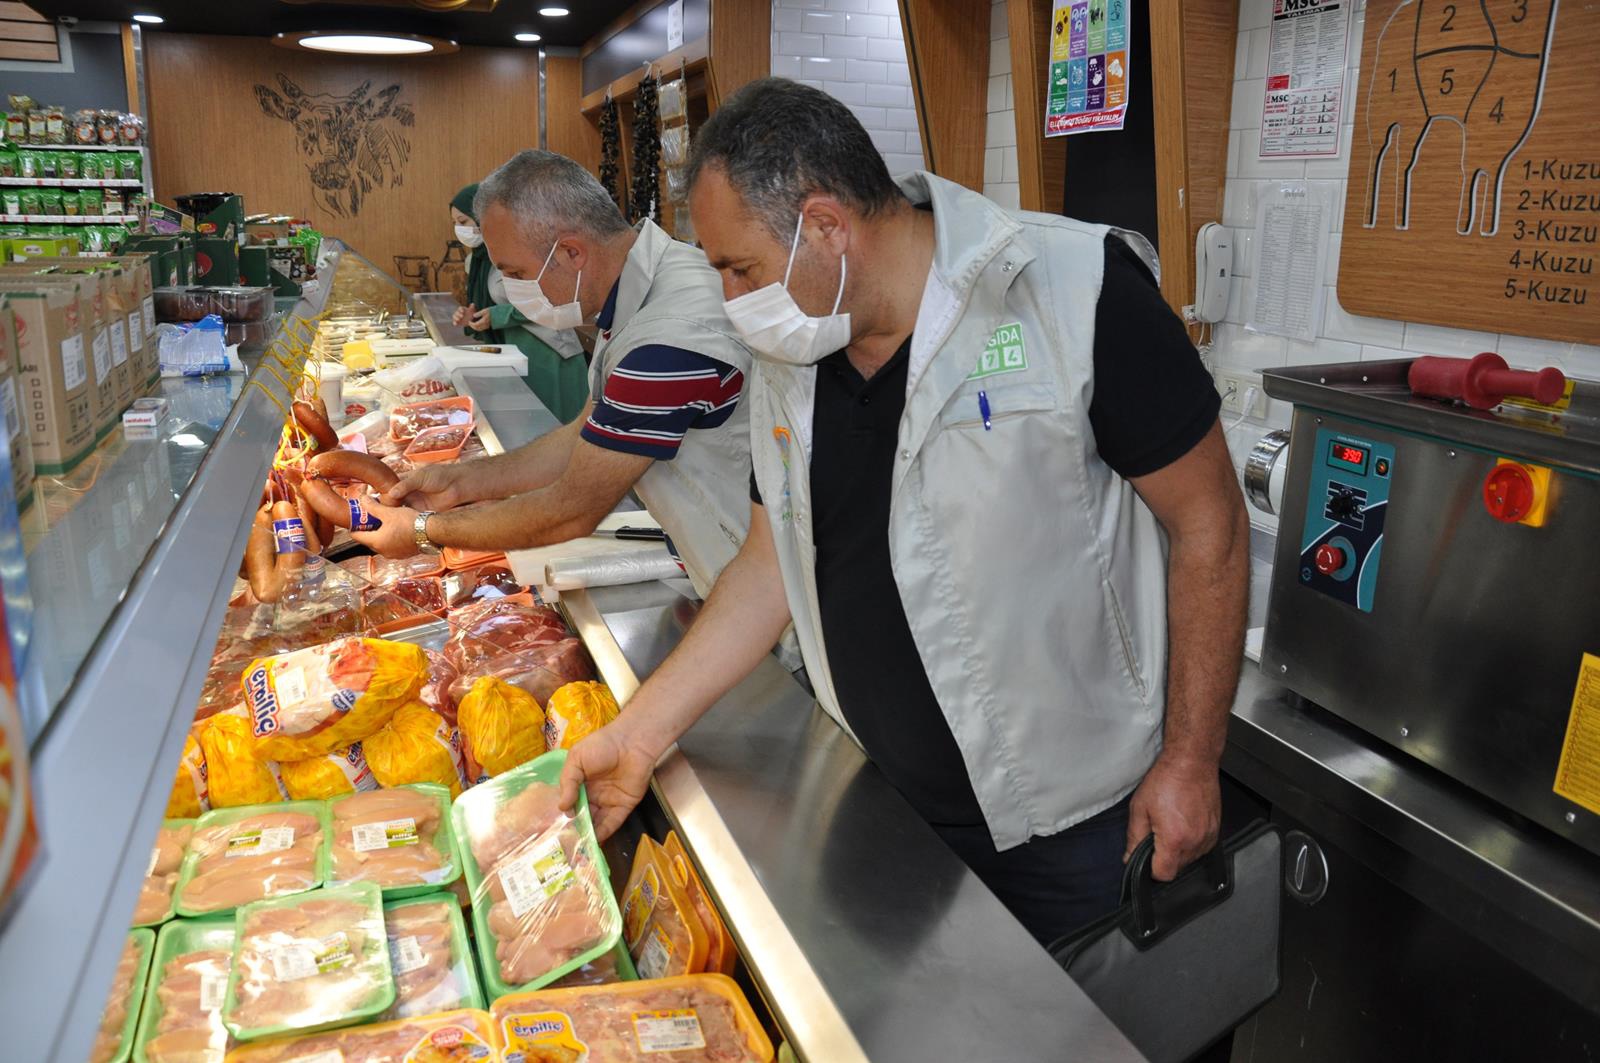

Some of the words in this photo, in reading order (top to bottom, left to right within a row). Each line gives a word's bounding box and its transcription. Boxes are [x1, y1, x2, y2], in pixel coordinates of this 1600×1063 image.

[1440, 4, 1456, 32] 2
[1512, 0, 1528, 23] 3
[1388, 67, 1397, 93] 1
[1440, 68, 1455, 95] 5
[1489, 96, 1504, 124] 4
[1523, 159, 1600, 181] 1-Kuzu
[1517, 189, 1600, 212] 2-Kuzu
[1513, 219, 1598, 243] 3-Kuzu
[1509, 249, 1593, 275] 4-Kuzu
[1504, 278, 1586, 305] 5-Kuzu
